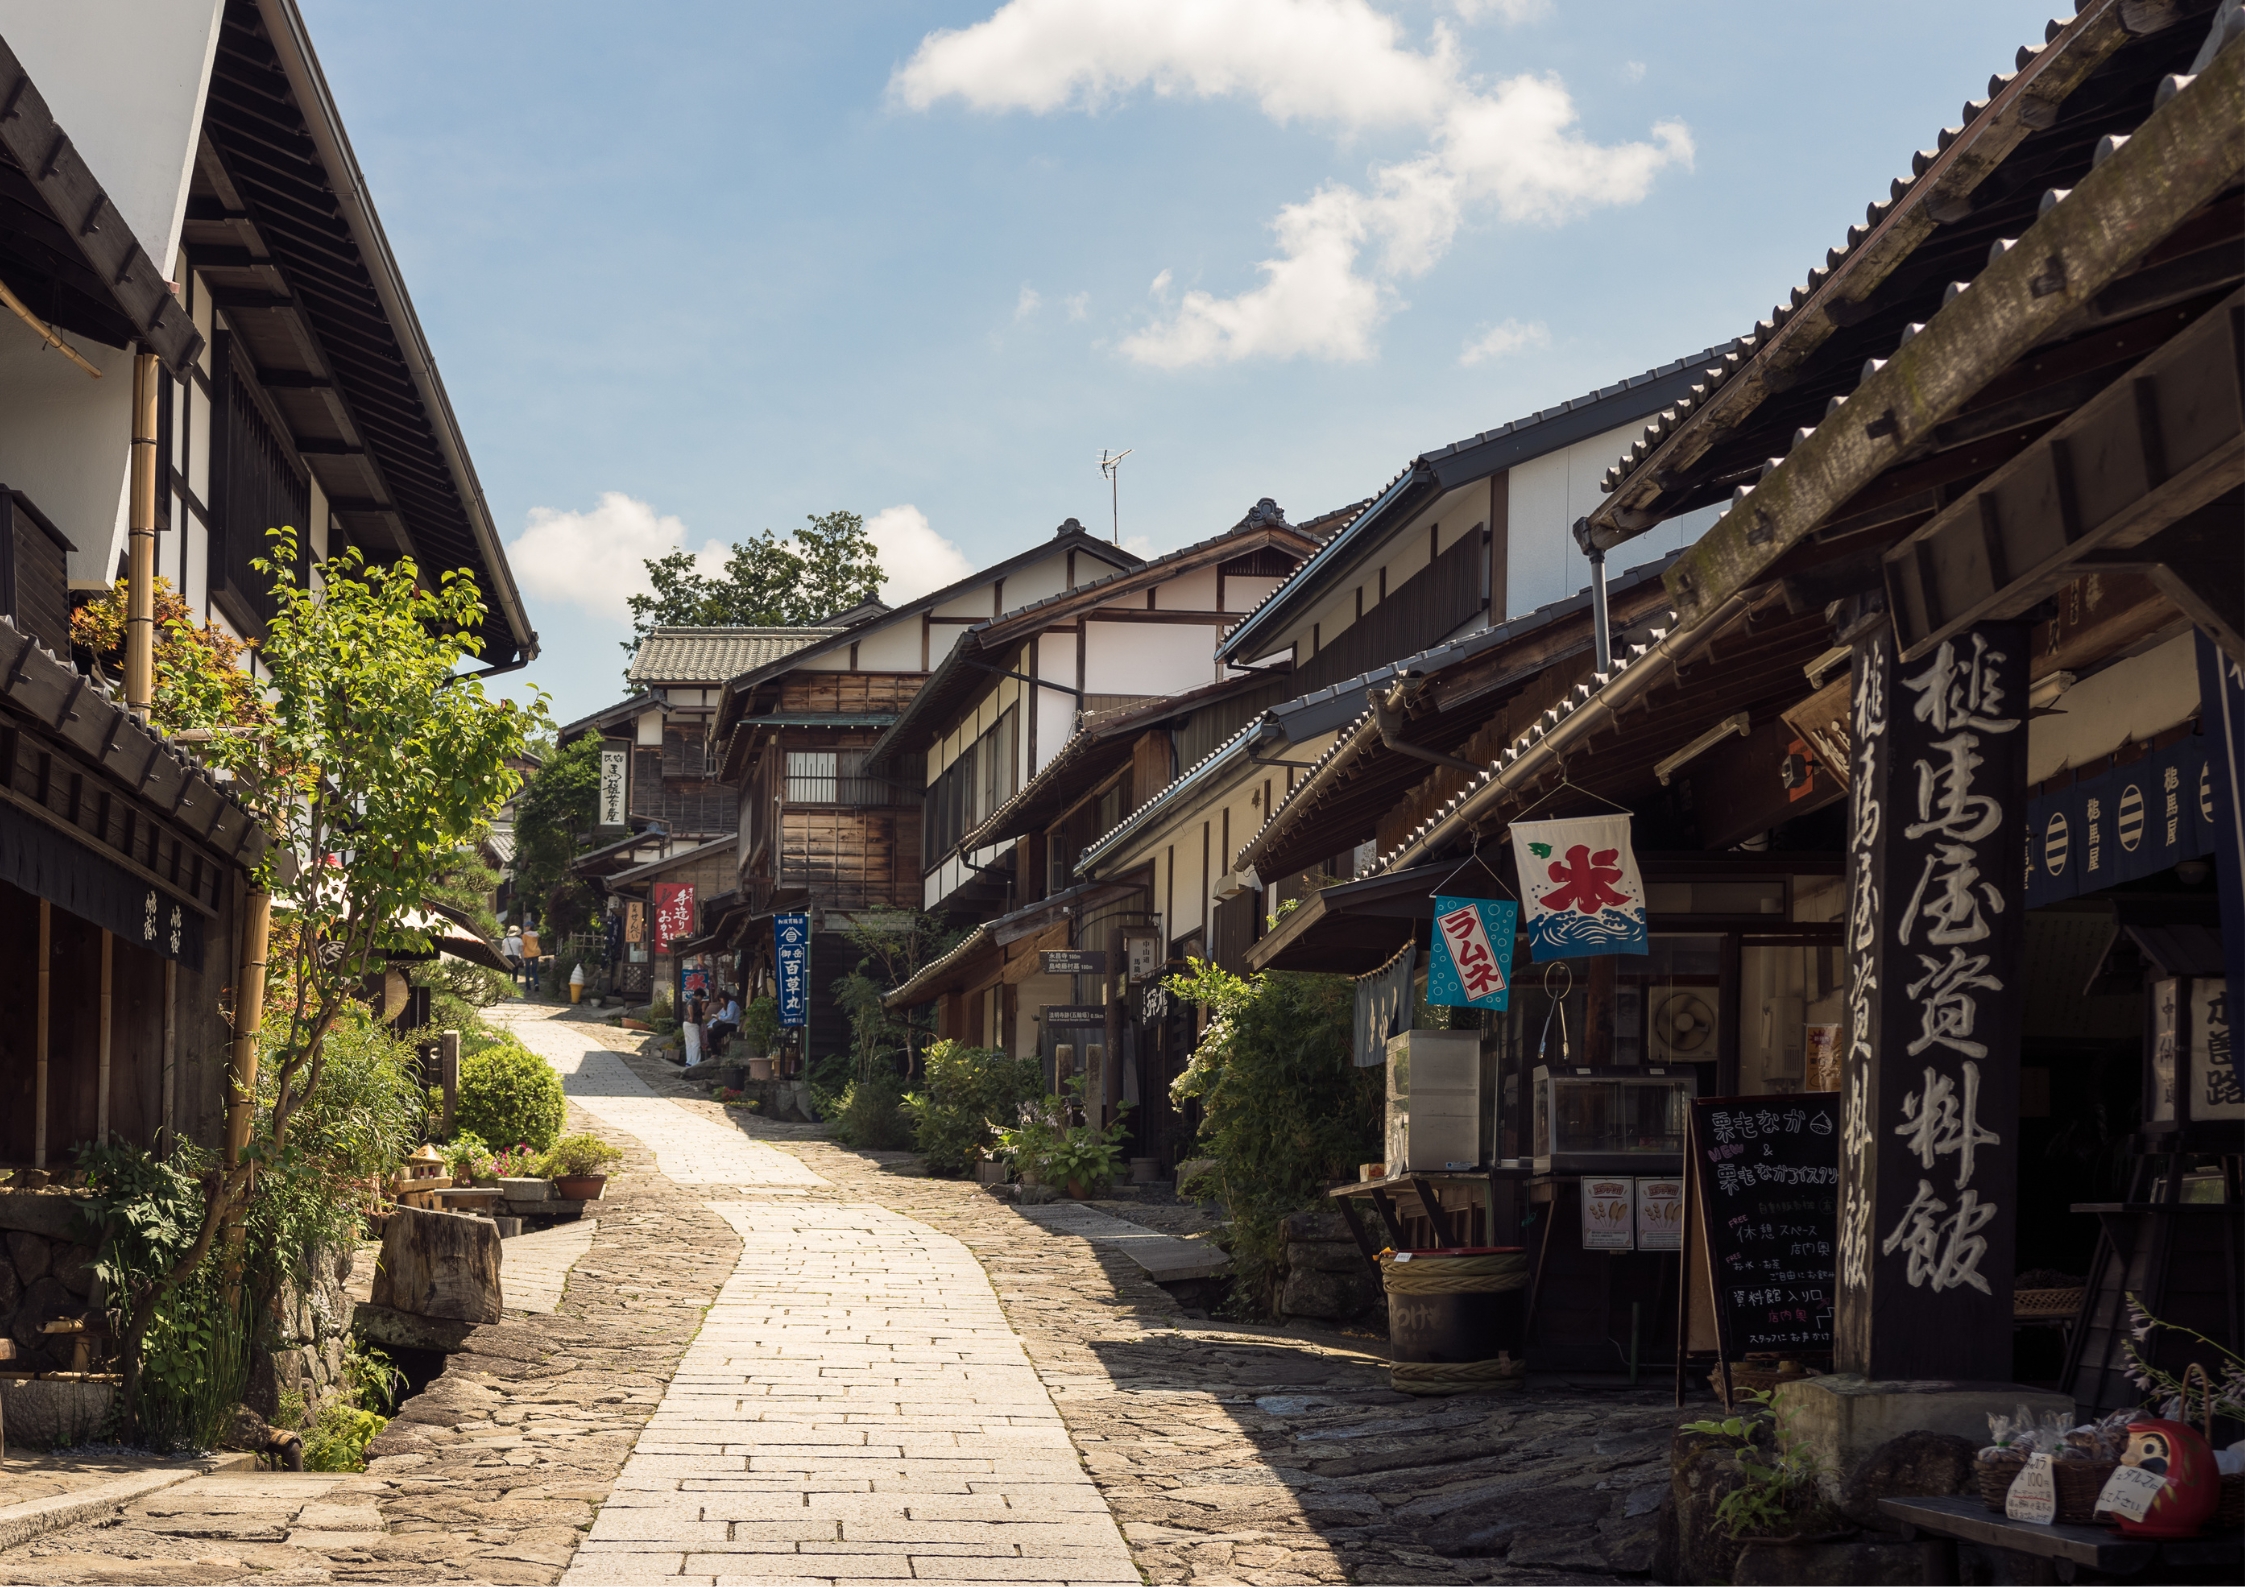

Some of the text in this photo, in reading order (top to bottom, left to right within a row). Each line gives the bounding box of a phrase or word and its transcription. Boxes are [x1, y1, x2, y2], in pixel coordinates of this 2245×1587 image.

[1539, 844, 1633, 914] 氷
[673, 889, 689, 930] 手造り
[781, 949, 803, 958] 御岳
[1445, 910, 1499, 993] ラムネ
[684, 973, 707, 991] 氷
[783, 960, 801, 1010] 百草丸
[1712, 1108, 1807, 1143] 栗もなか
[1707, 1143, 1744, 1162] NEW
[1763, 1143, 1773, 1156] &
[1717, 1163, 1839, 1196] 栗もなかアイスクリ
[1728, 1214, 1748, 1229] FREE
[1736, 1223, 1818, 1243] 休憩 スペース
[1725, 1252, 1742, 1264] FREE
[1791, 1241, 1830, 1256] 店内奥
[1733, 1288, 1822, 1307] 資料館 入り口
[1768, 1308, 1807, 1323] 店内奥
